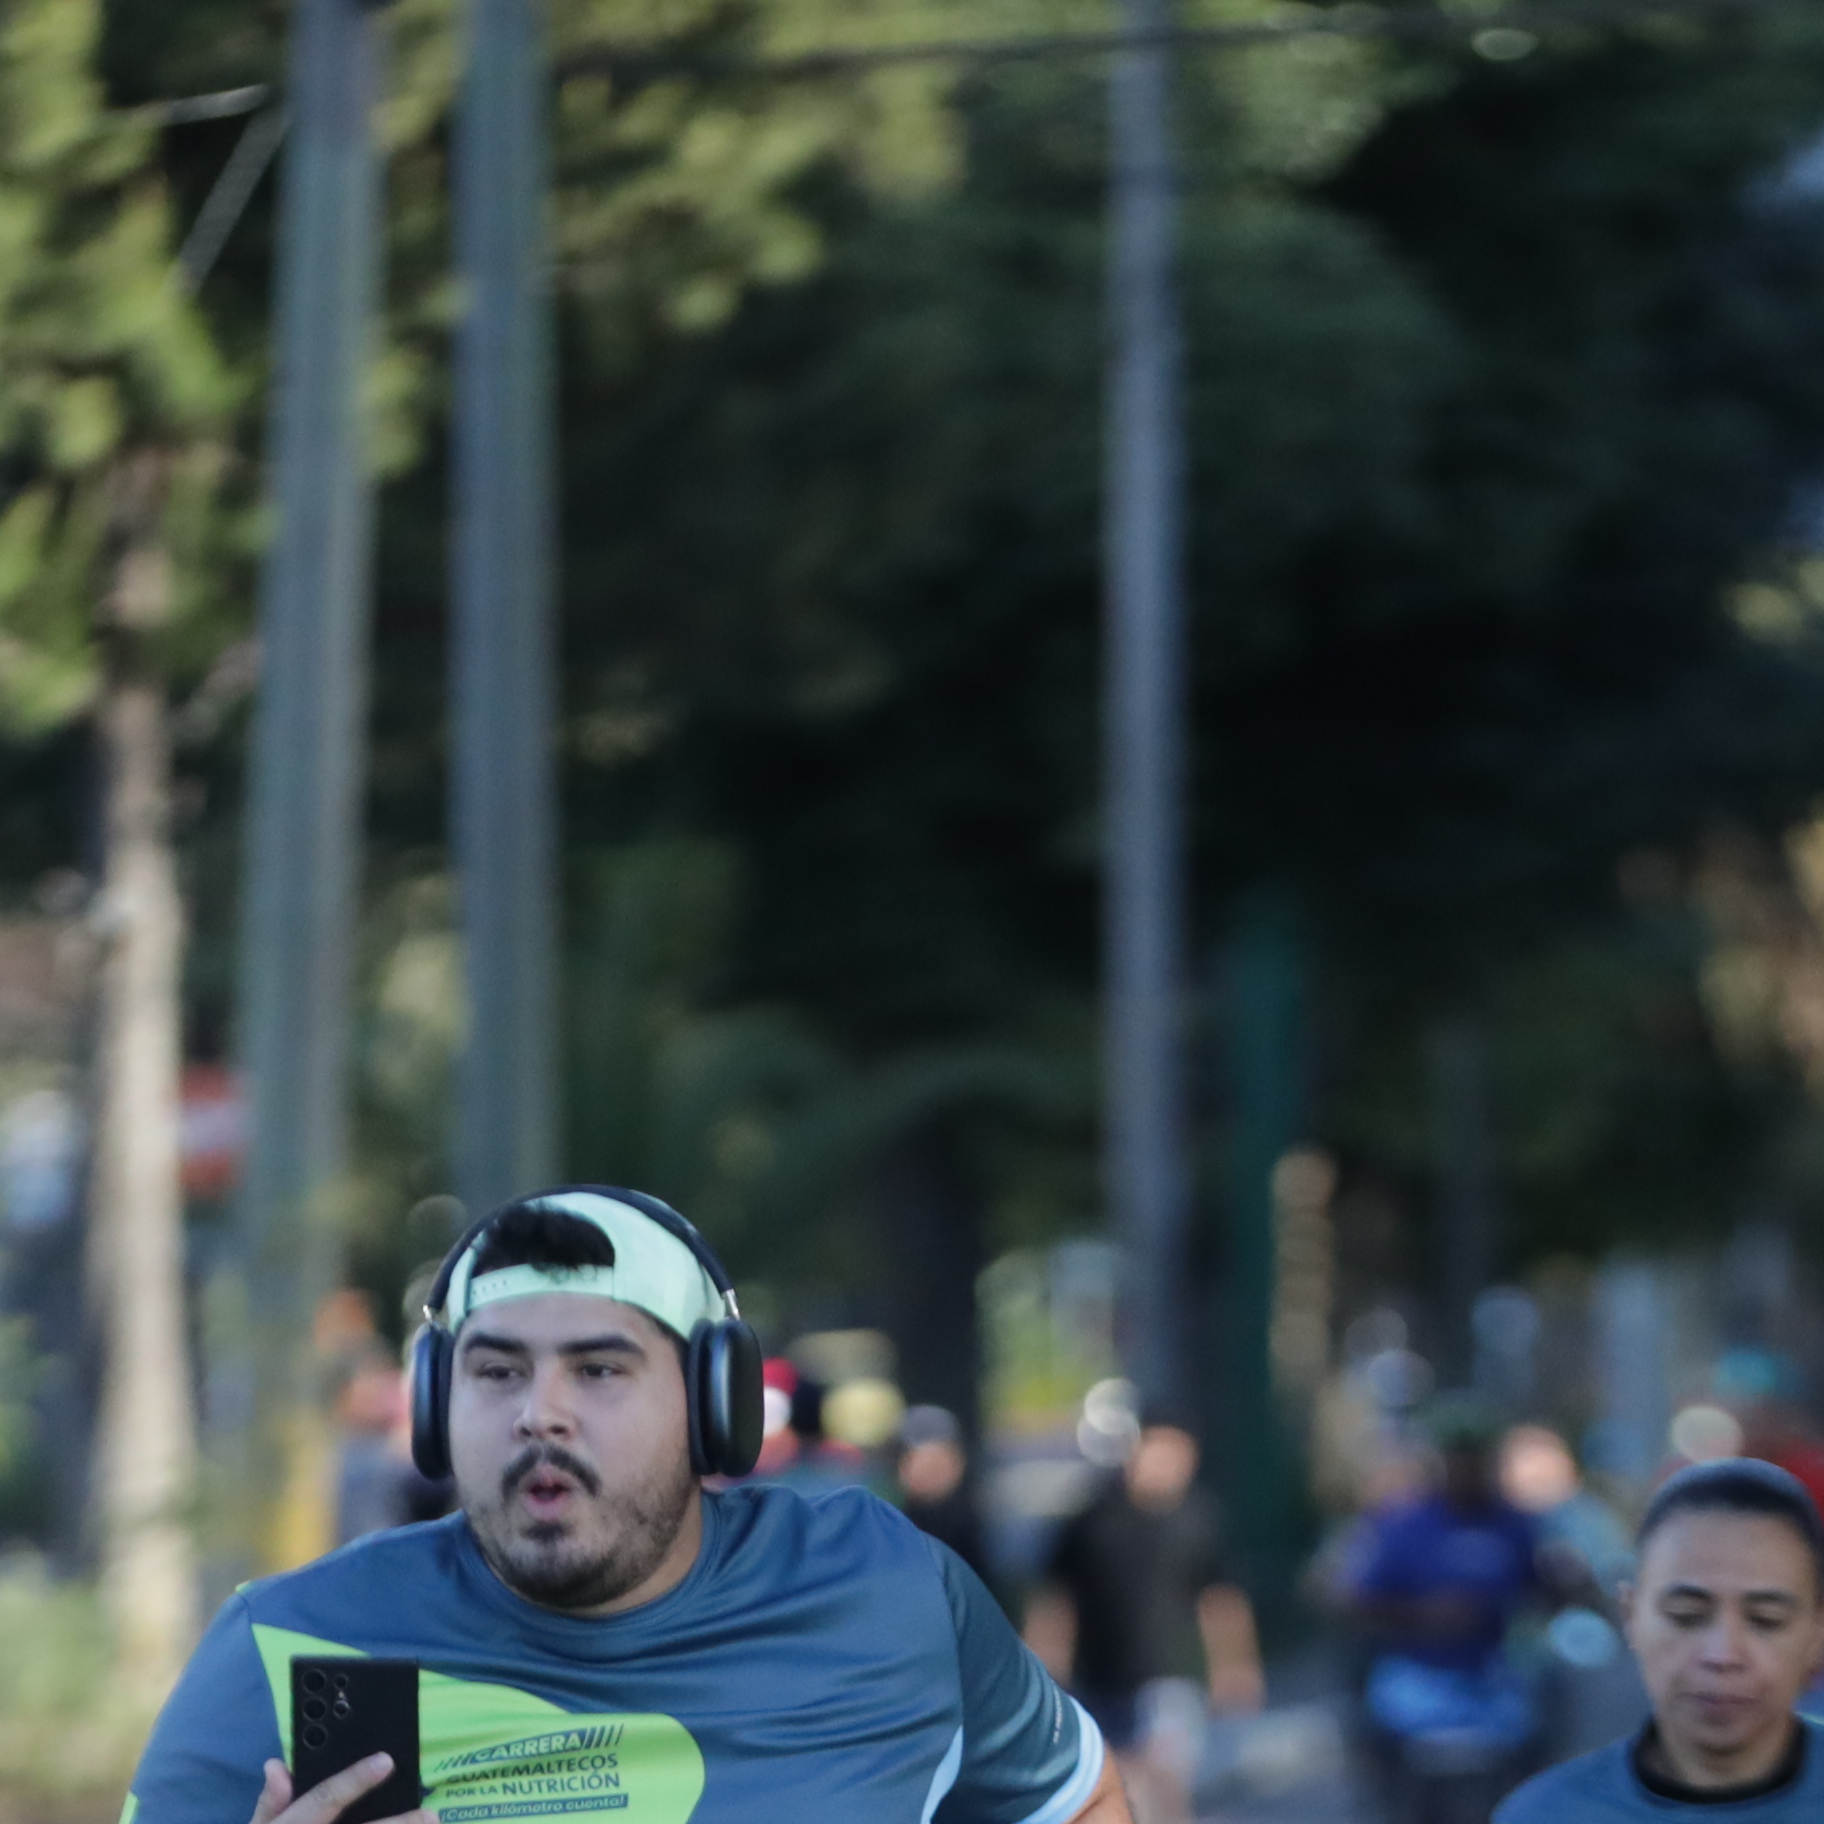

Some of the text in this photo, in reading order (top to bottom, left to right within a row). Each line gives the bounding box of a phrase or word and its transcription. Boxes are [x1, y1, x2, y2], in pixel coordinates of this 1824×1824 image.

[474, 1731, 582, 1761] CARRERA
[445, 1753, 619, 1785] GUATEMALTECOS
[446, 1769, 621, 1799] POR LA NUTRICIÓN
[490, 1801, 564, 1817] kilómetro
[565, 1795, 625, 1812] cuenta!
